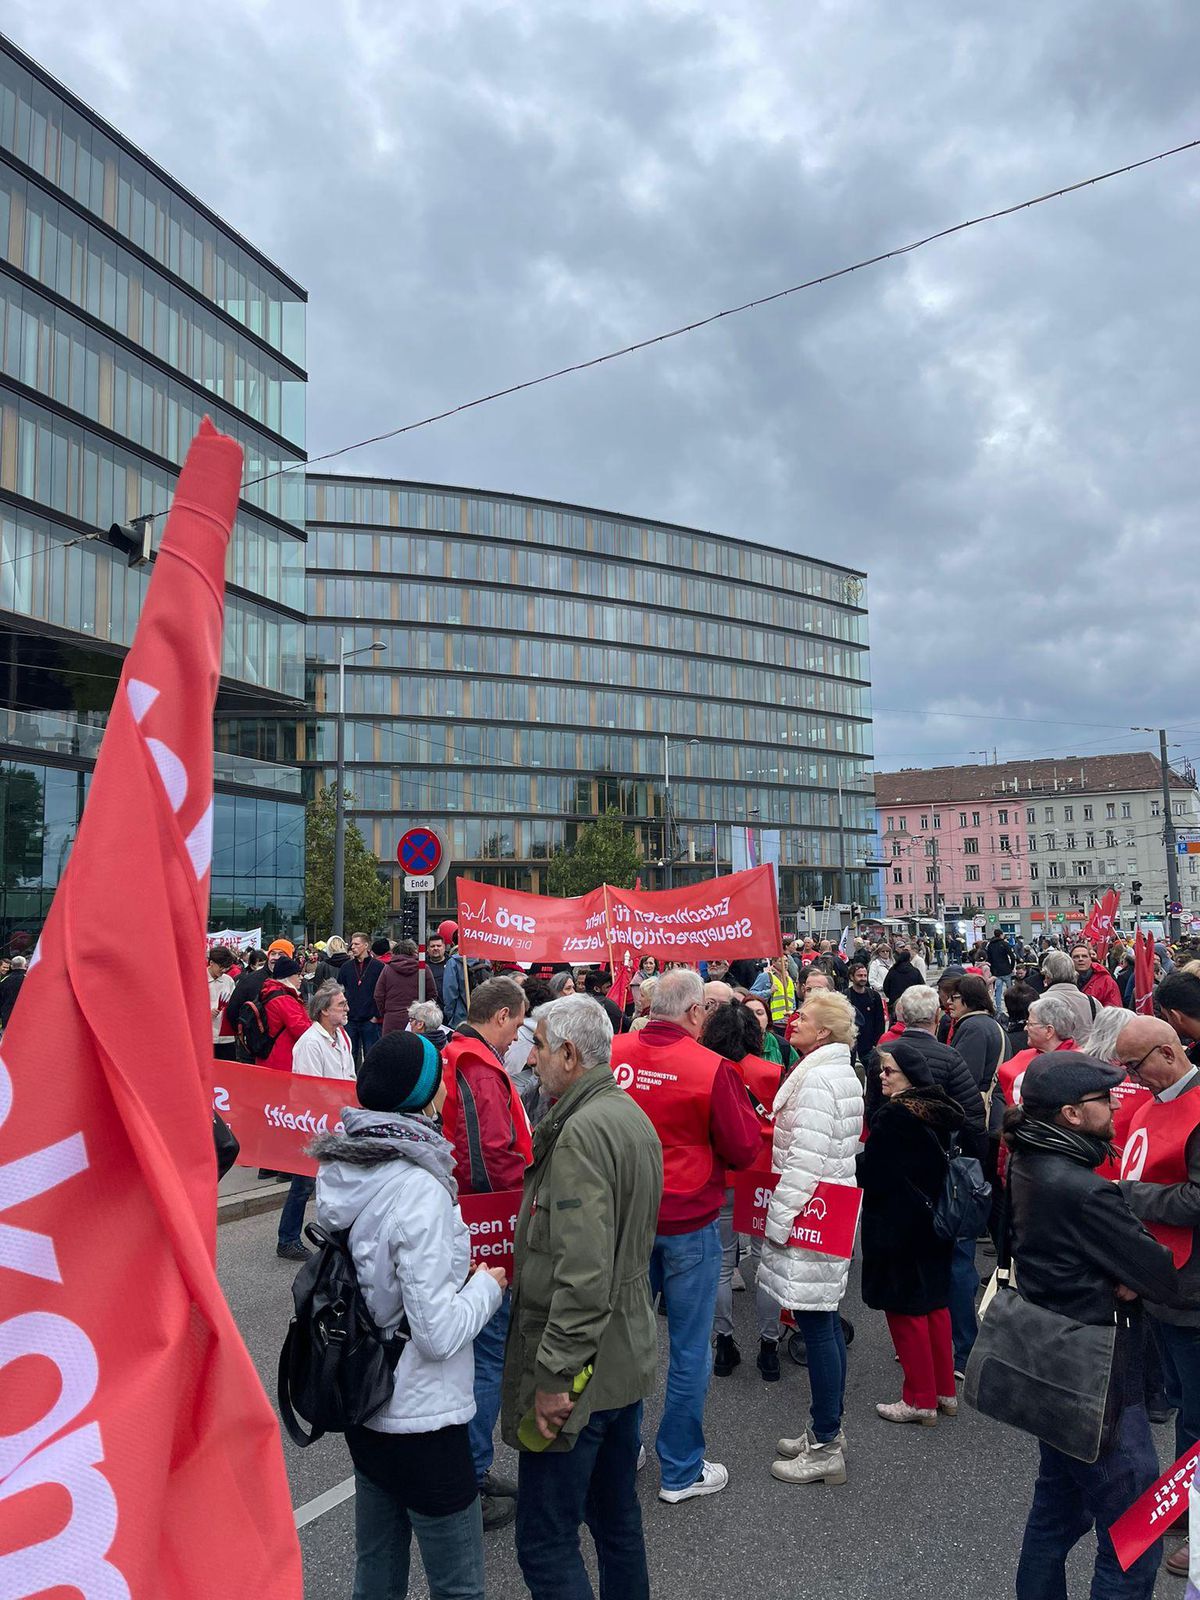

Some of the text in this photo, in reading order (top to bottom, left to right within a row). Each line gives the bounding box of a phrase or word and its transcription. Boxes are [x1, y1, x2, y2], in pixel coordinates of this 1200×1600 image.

[411, 879, 429, 888] Ende
[636, 1076, 663, 1086] VERBAND
[637, 1069, 678, 1081] PENSIONISTEN
[752, 1216, 765, 1231] DIE
[790, 1226, 823, 1245] ARTEI.
[471, 1238, 514, 1258] rech
[1150, 1491, 1180, 1524] für
